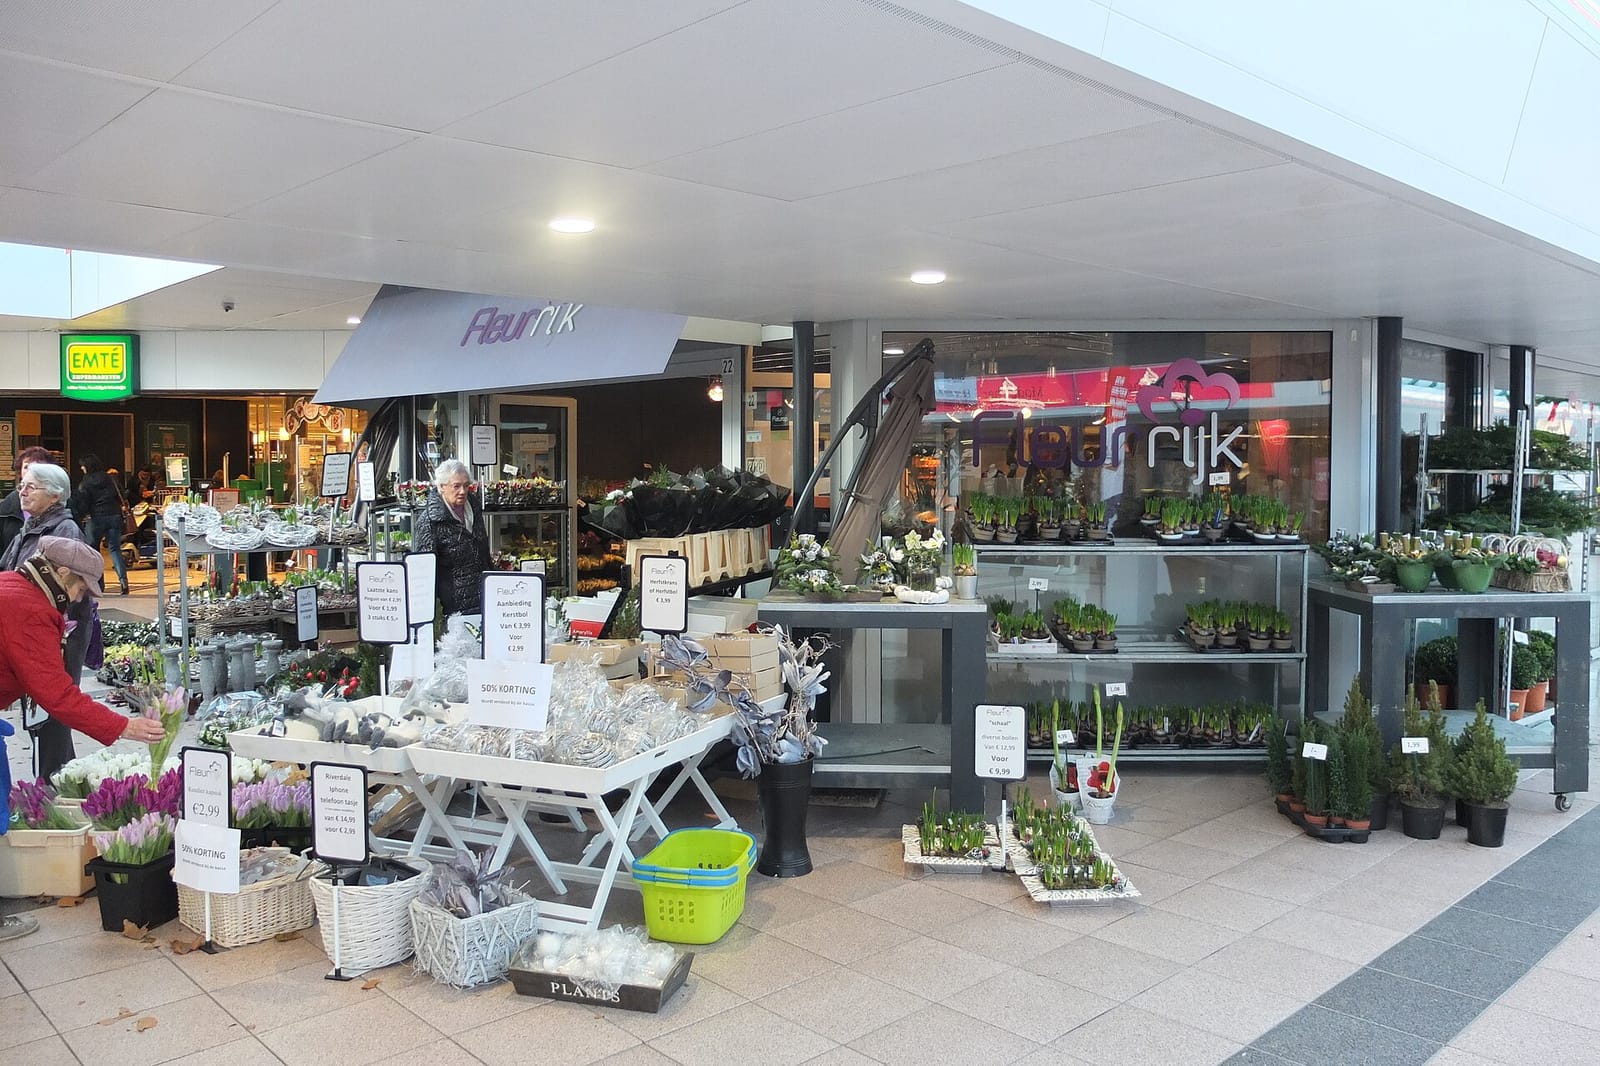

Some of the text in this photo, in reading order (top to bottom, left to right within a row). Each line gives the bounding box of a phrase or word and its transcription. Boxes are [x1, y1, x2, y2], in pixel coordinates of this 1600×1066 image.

[72, 347, 120, 368] EMTÉ
[723, 360, 733, 373] 22
[972, 411, 1243, 485] Fleurrijk
[481, 684, 536, 695] 50% KORTING
[326, 773, 352, 782] Riverdale
[320, 796, 344, 805] telefoon
[194, 848, 226, 859] KORTING
